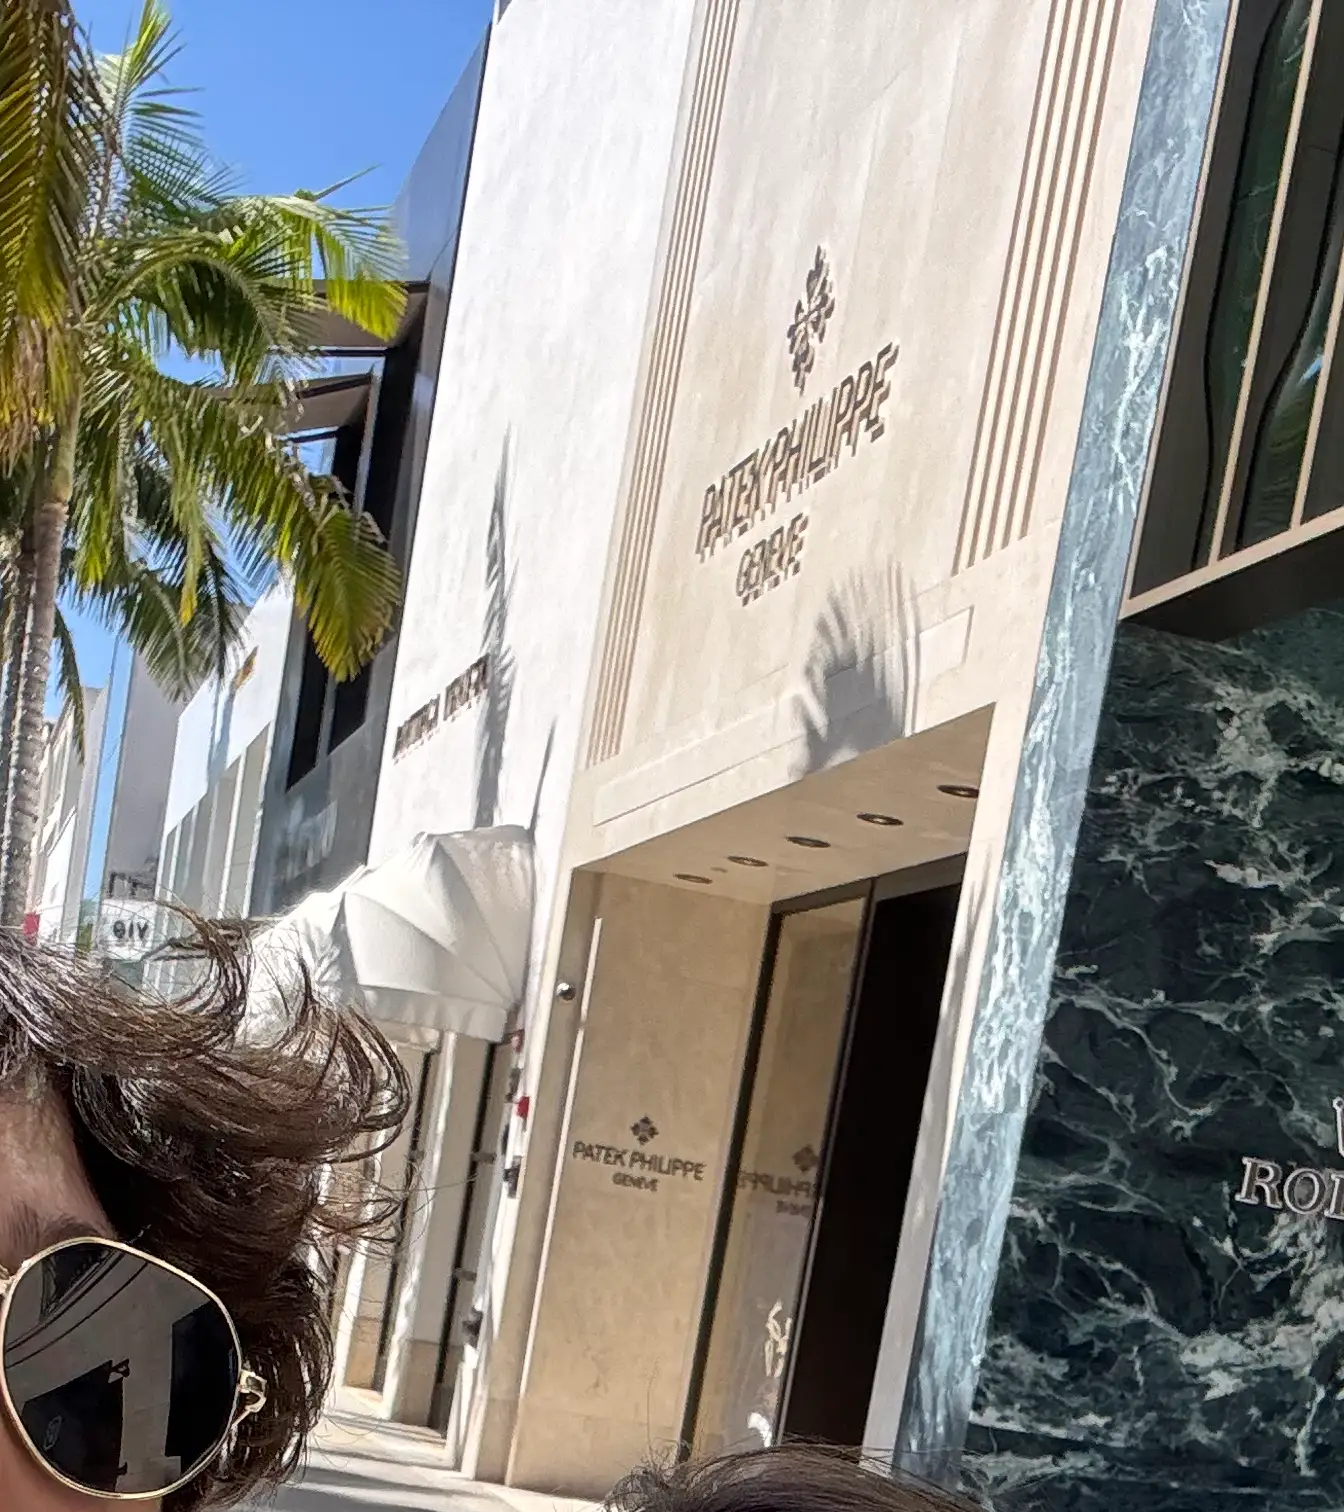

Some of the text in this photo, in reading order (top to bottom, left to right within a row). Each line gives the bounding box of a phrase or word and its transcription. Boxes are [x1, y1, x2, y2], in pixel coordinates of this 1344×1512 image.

[695, 343, 897, 562] PATEK PHILIPPE
[572, 1141, 707, 1182] PATEK PHILIPPE
